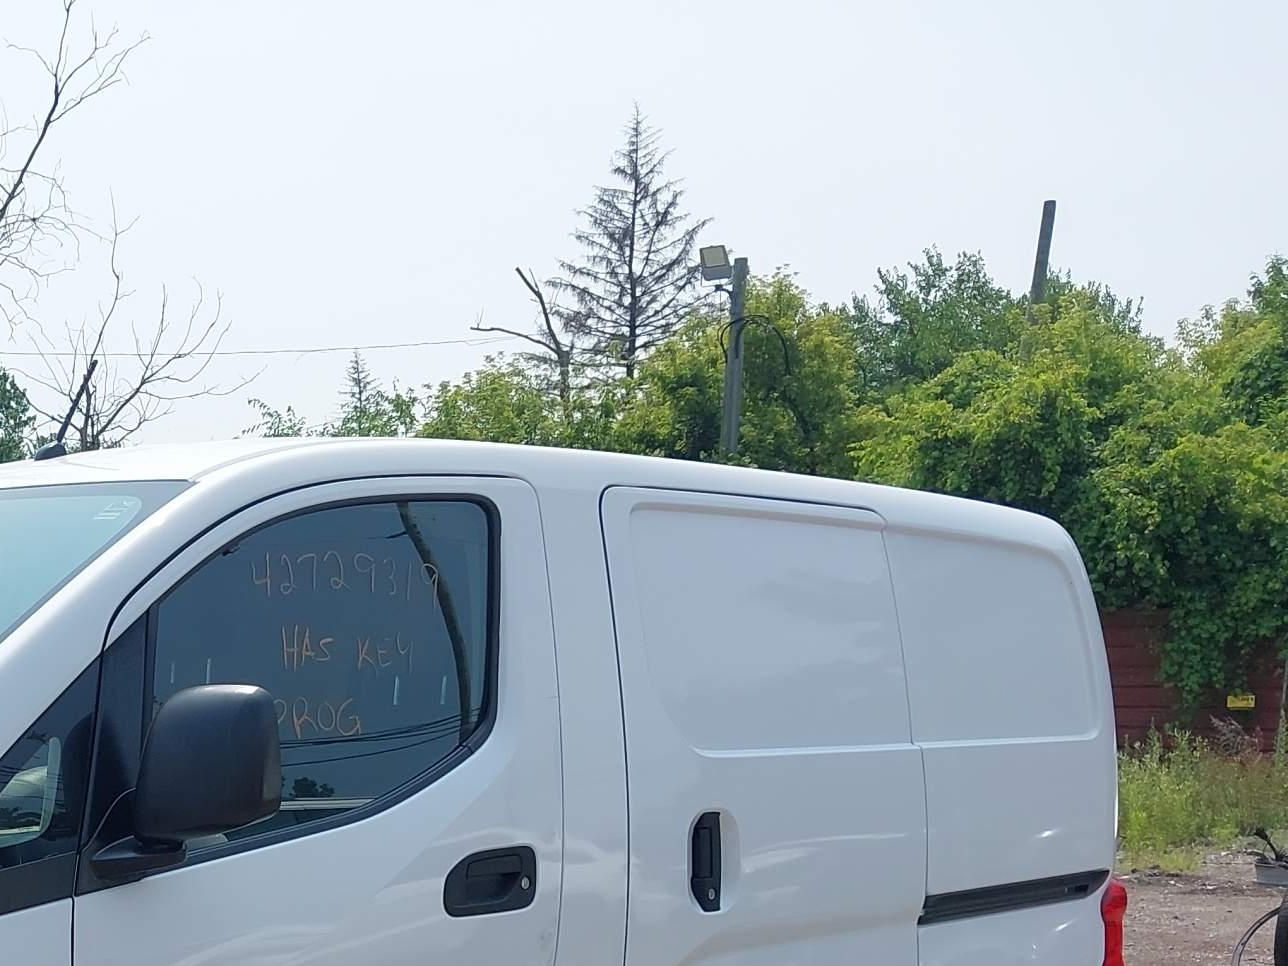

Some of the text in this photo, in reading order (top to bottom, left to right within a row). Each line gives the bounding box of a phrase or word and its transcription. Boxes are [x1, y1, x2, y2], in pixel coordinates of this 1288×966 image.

[249, 550, 440, 608] 42729319
[281, 623, 413, 679] HAS KEY
